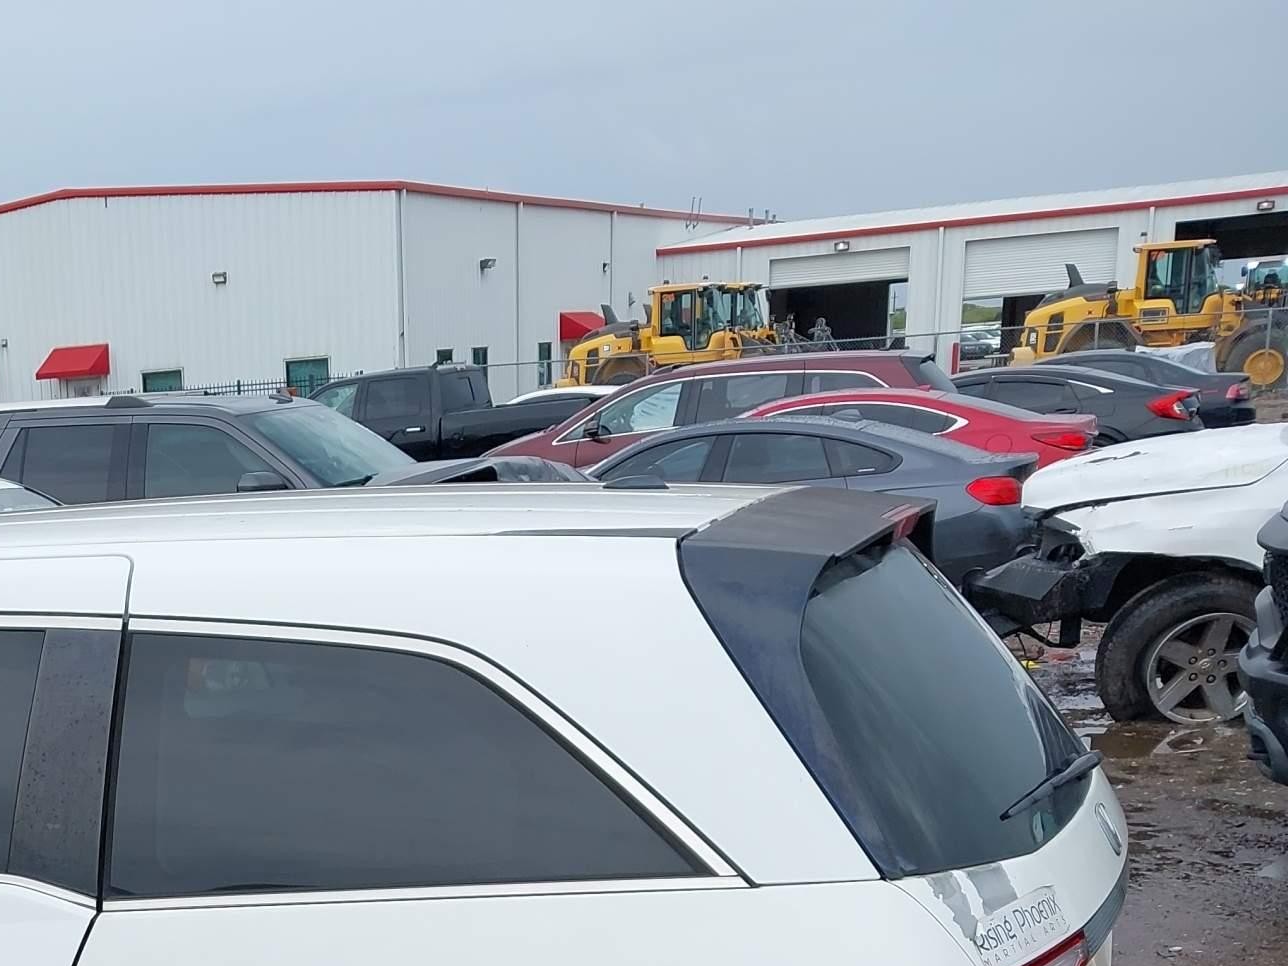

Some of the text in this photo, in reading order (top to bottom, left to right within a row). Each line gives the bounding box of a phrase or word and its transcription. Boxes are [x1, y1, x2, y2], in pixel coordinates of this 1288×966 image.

[973, 892, 1062, 956] Rising Phoenix
[1043, 915, 1067, 937] ARTS
